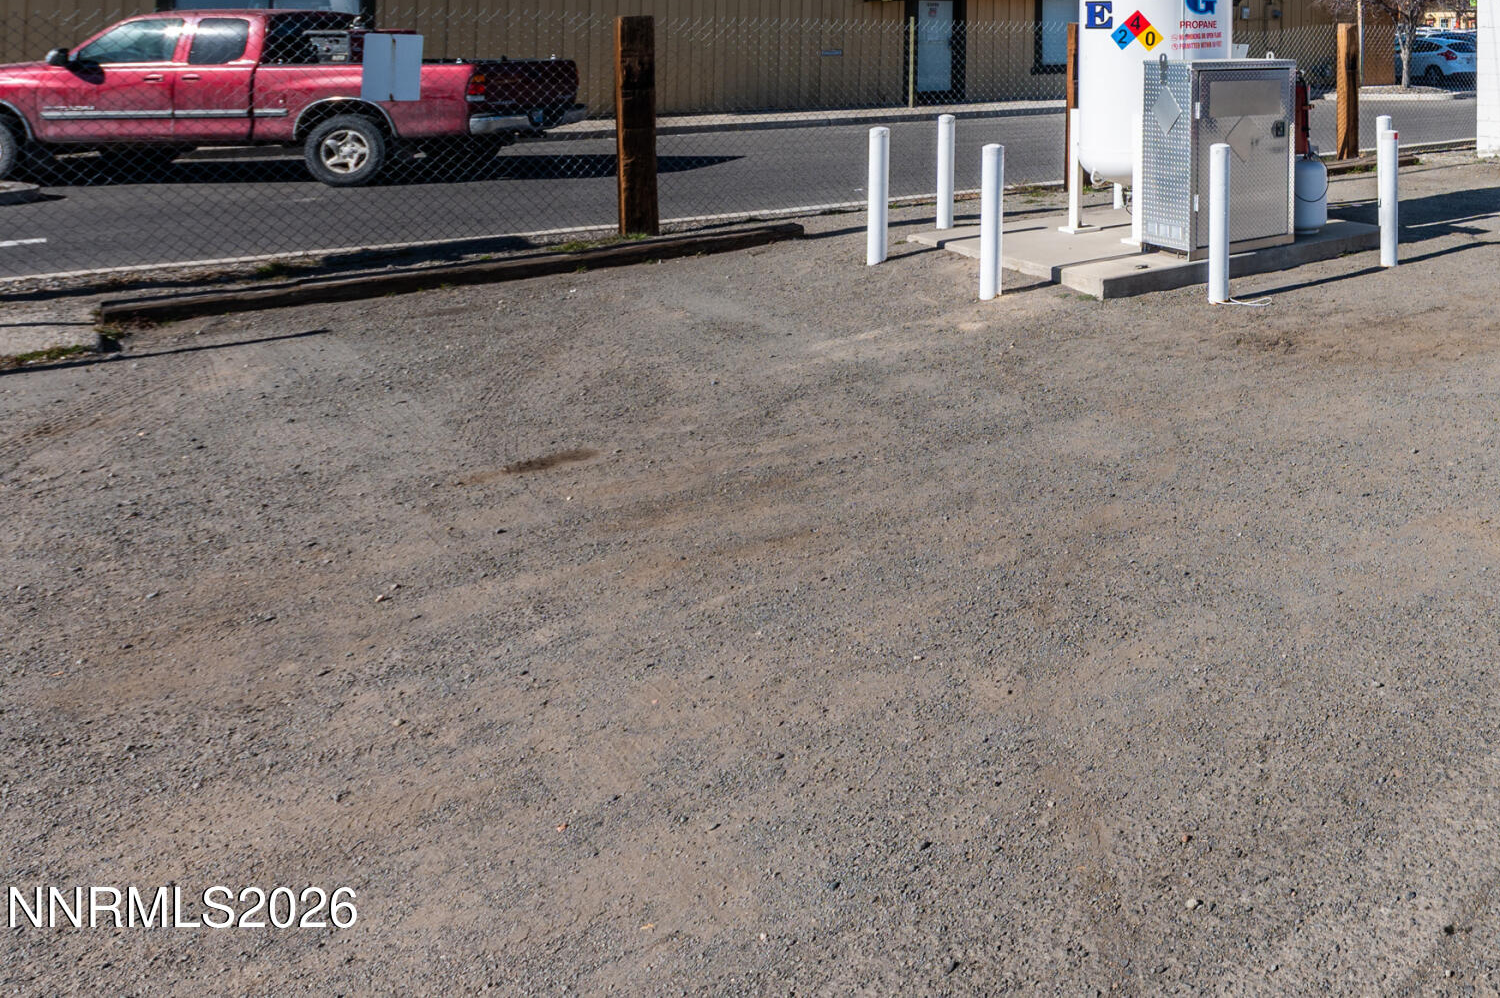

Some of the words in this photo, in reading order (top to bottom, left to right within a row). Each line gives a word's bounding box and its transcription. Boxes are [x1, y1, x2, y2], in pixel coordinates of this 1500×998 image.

[1130, 15, 1141, 30] 4
[1179, 20, 1217, 29] PROPANE
[1118, 29, 1128, 44] 2
[1145, 31, 1156, 47] 0
